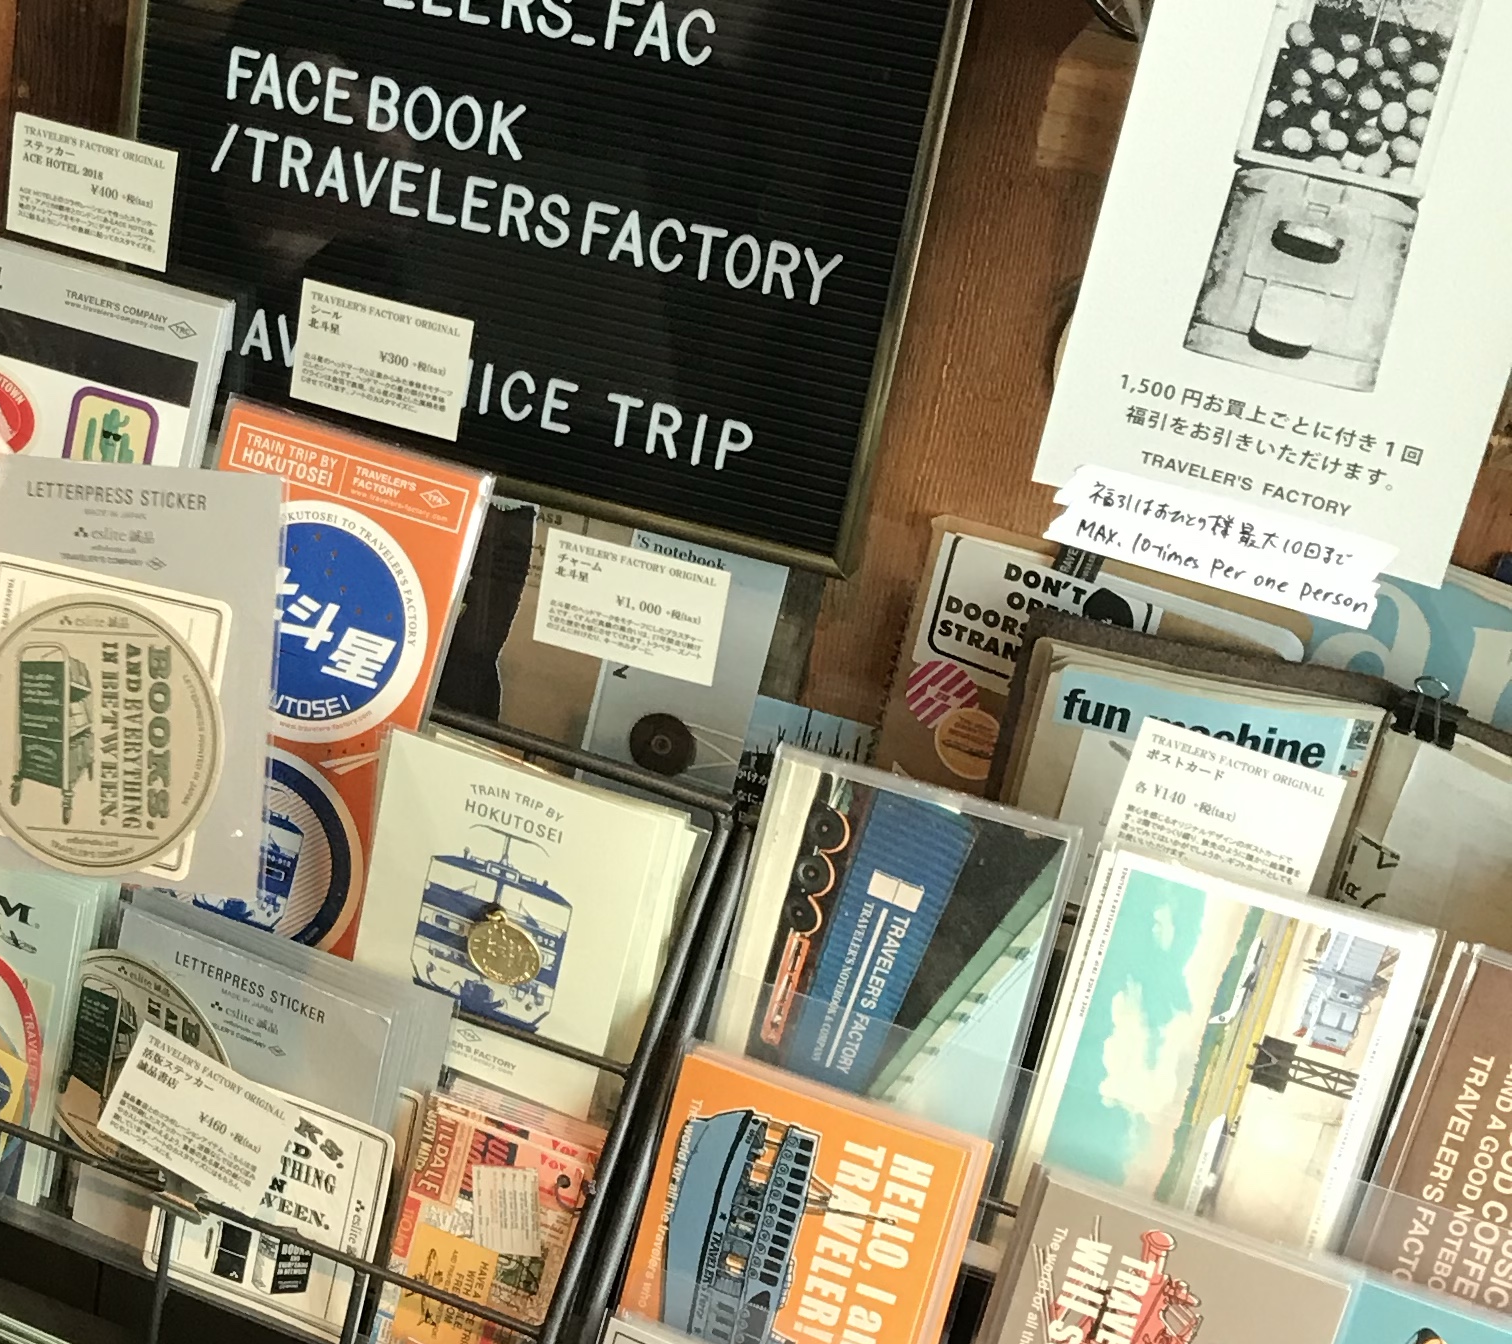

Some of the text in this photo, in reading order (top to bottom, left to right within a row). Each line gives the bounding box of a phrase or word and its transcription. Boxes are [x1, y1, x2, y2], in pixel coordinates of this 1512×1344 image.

[22, 152, 104, 181] ACE HOTEL 2018
[23, 139, 75, 157] ステッカー
[24, 125, 165, 170] TRAVELER'S FACTORY ORIGINAL
[90, 184, 118, 201] ¥400
[65, 288, 168, 325] TRAVELER'S COMPANY
[308, 317, 341, 335] 北斗星
[310, 305, 342, 320] シール
[311, 291, 461, 337] TRAVELER'S FACTORY ORIGINAL
[379, 351, 409, 368] ¥300
[247, 432, 339, 470] TRAIN TRIP BY
[608, 392, 754, 471] TRIP
[1125, 406, 1393, 491] 福引をお引きいただけます。
[241, 446, 335, 488] HOKUTOSEI
[352, 477, 400, 499] FACTORY
[355, 465, 417, 492] TRAVELER'S
[1141, 451, 1352, 517] TRAVELER'S FACTORY
[26, 480, 207, 511] LETTERPRESS STICKER
[555, 566, 589, 583] 北斗星
[557, 553, 603, 573] チャーム
[558, 540, 717, 588] TRAVELER'S FACTORY ORIGINAL
[1076, 519, 1122, 547] MAX.
[1254, 573, 1289, 593] one
[1003, 562, 1087, 606] DON'T
[98, 641, 120, 827] IN BETWEEN.
[120, 642, 145, 831] AND EVERYTHING
[146, 642, 173, 831] BOOKS.
[1062, 688, 1326, 769] fun hine
[1146, 748, 1225, 782] ポストカード
[1150, 733, 1325, 797] TRAVELER'S FACTORY ORIGINAL
[470, 783, 564, 823] TRAIN TRIP BY
[1153, 782, 1186, 807] ¥140
[464, 798, 564, 845] HOKUTOSEI
[175, 951, 326, 1024] LETTERPRESS STICKER
[835, 913, 912, 1075] TRAVELER'S FACTORY
[224, 1005, 256, 1028] eslite
[136, 1058, 180, 1091] 誠品書店
[142, 1047, 215, 1092] 活版ステッカー
[148, 1034, 286, 1121] TRAVELER'S FACTORY ORIGINAL
[197, 1110, 228, 1135] ¥460
[1422, 1055, 1496, 1204] TRAVELER'S
[858, 1153, 935, 1272] HELLO,
[792, 1140, 887, 1344] TRAVELER!
